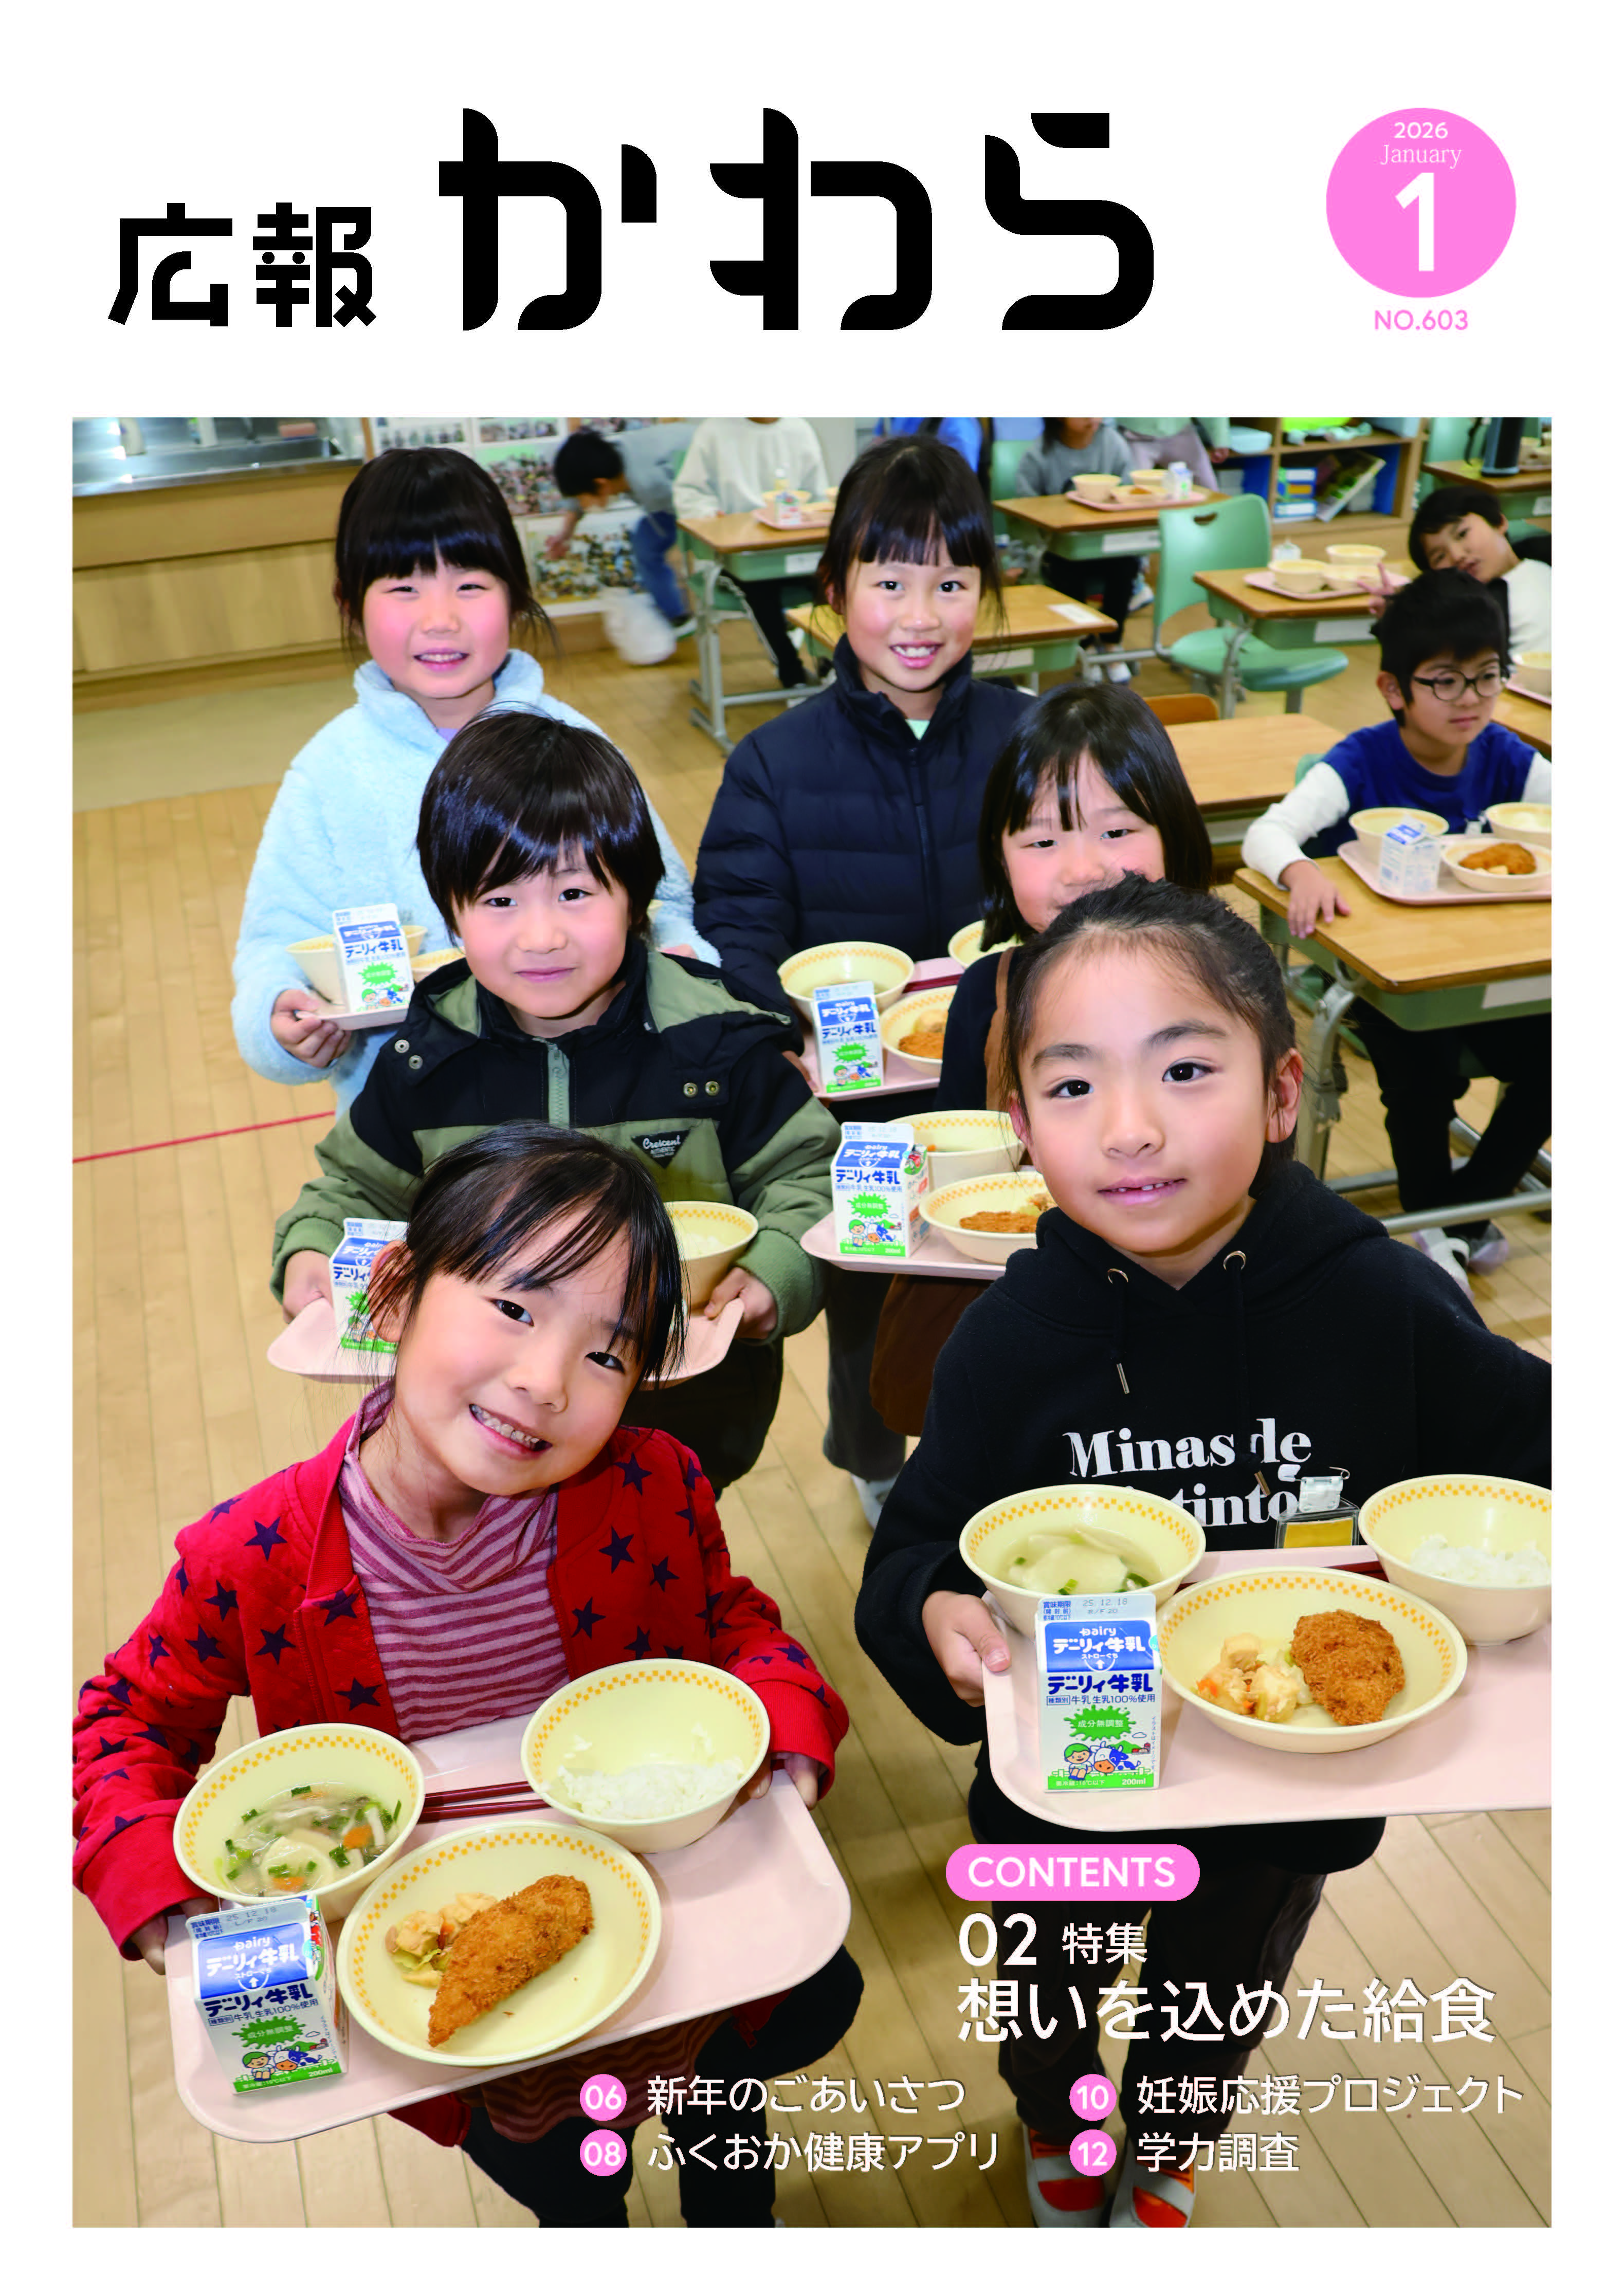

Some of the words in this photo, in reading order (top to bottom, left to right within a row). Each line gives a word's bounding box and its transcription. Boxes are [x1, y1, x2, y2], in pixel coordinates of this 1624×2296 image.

[836, 1169, 900, 1184] デーリィ牛乳
[1062, 1427, 1235, 1477] Minas
[1250, 1418, 1311, 1464] de
[1053, 1636, 1146, 1654] デーリィ牛乳
[1048, 1673, 1153, 1695] デーリィ牛乳
[1078, 1719, 1124, 1728] 成分無調整
[206, 1943, 299, 1977] デーリィ牛乳
[204, 1983, 313, 2017] デーリィ牛乳
[308, 2068, 334, 2077] 200ml
